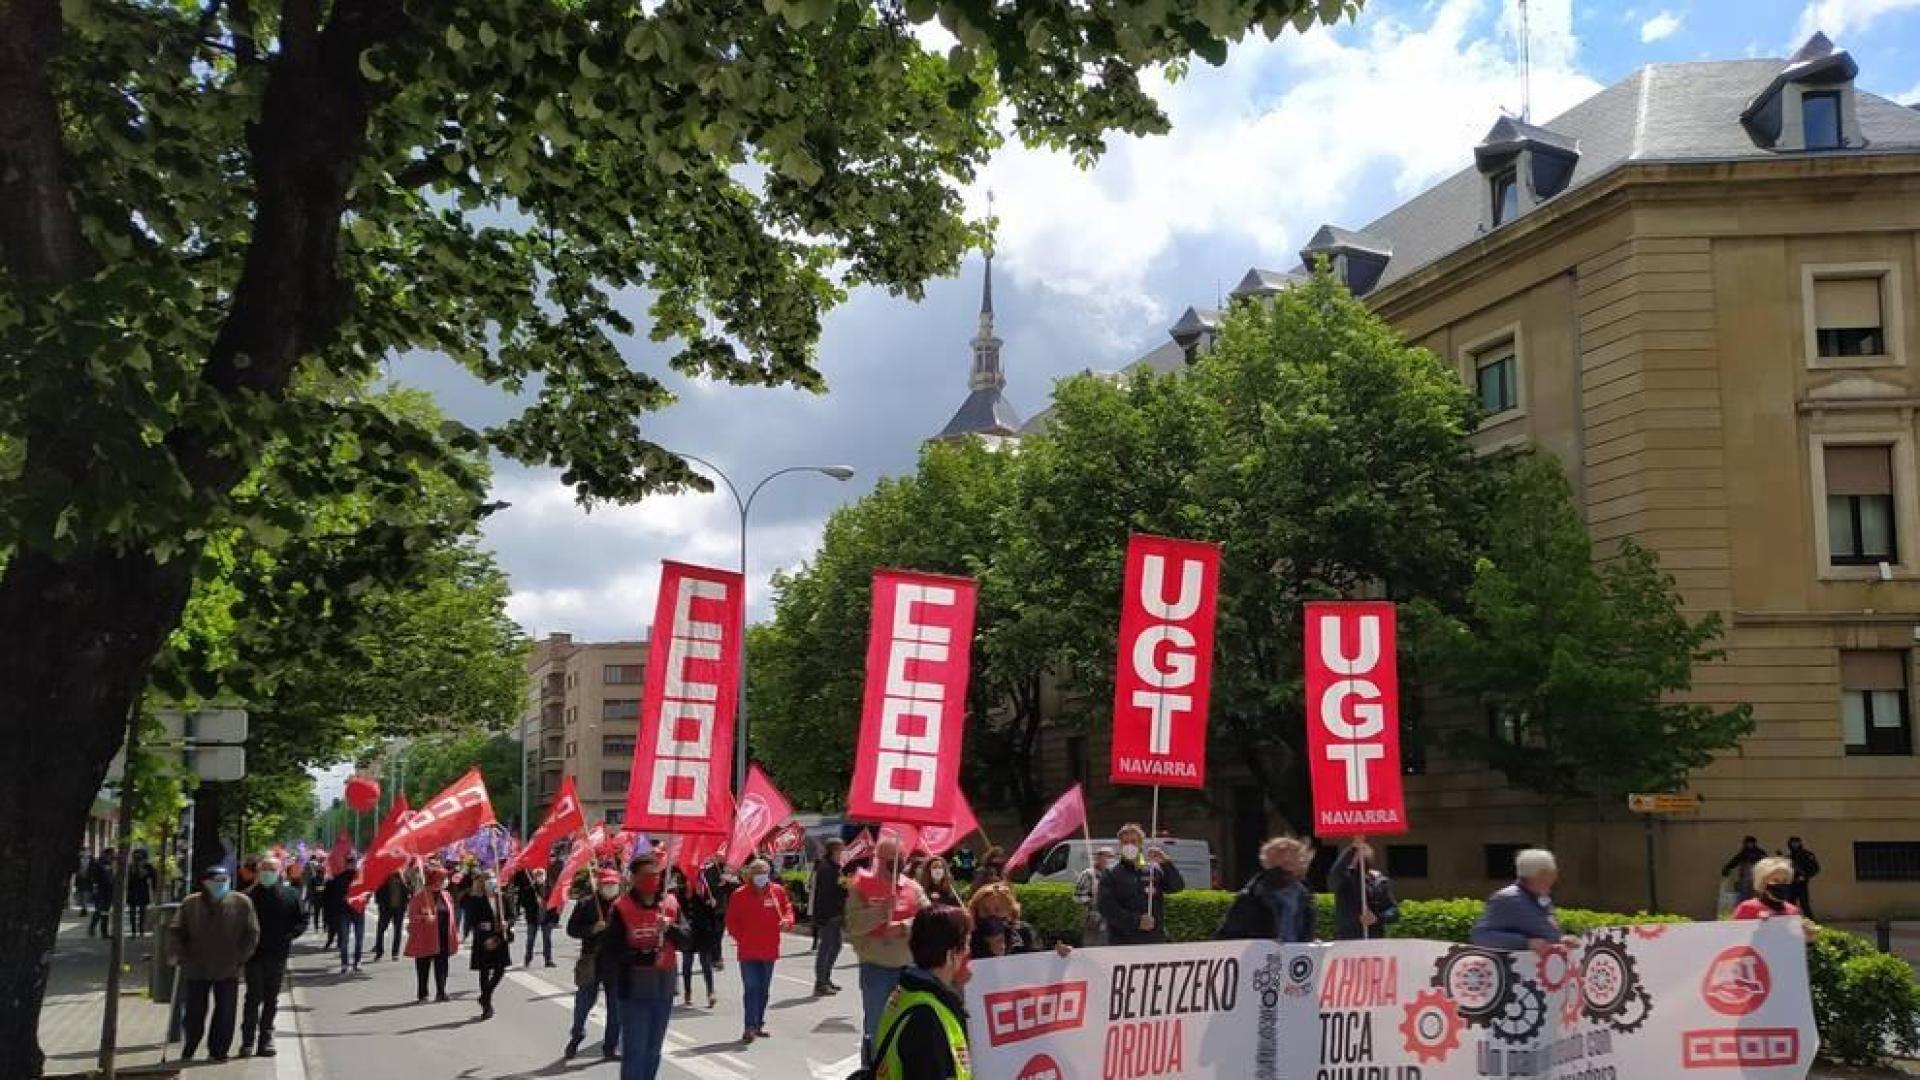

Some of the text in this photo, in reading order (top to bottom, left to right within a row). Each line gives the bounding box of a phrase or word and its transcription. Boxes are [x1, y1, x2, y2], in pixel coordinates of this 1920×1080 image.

[1133, 554, 1204, 755] UGT
[648, 576, 727, 817] CCOO
[872, 582, 956, 809] CCOO
[1320, 615, 1385, 802] UGT
[1120, 757, 1197, 777] NAVARRA
[1321, 809, 1399, 825] NAVARRA
[1108, 957, 1240, 1021] BETETZEKO
[1319, 955, 1397, 1008] AHORA
[991, 989, 1081, 1036] CCOO
[1318, 1010, 1373, 1065] TOCA
[1103, 1018, 1183, 1080] ORDUA
[1688, 1034, 1793, 1062] CCOO
